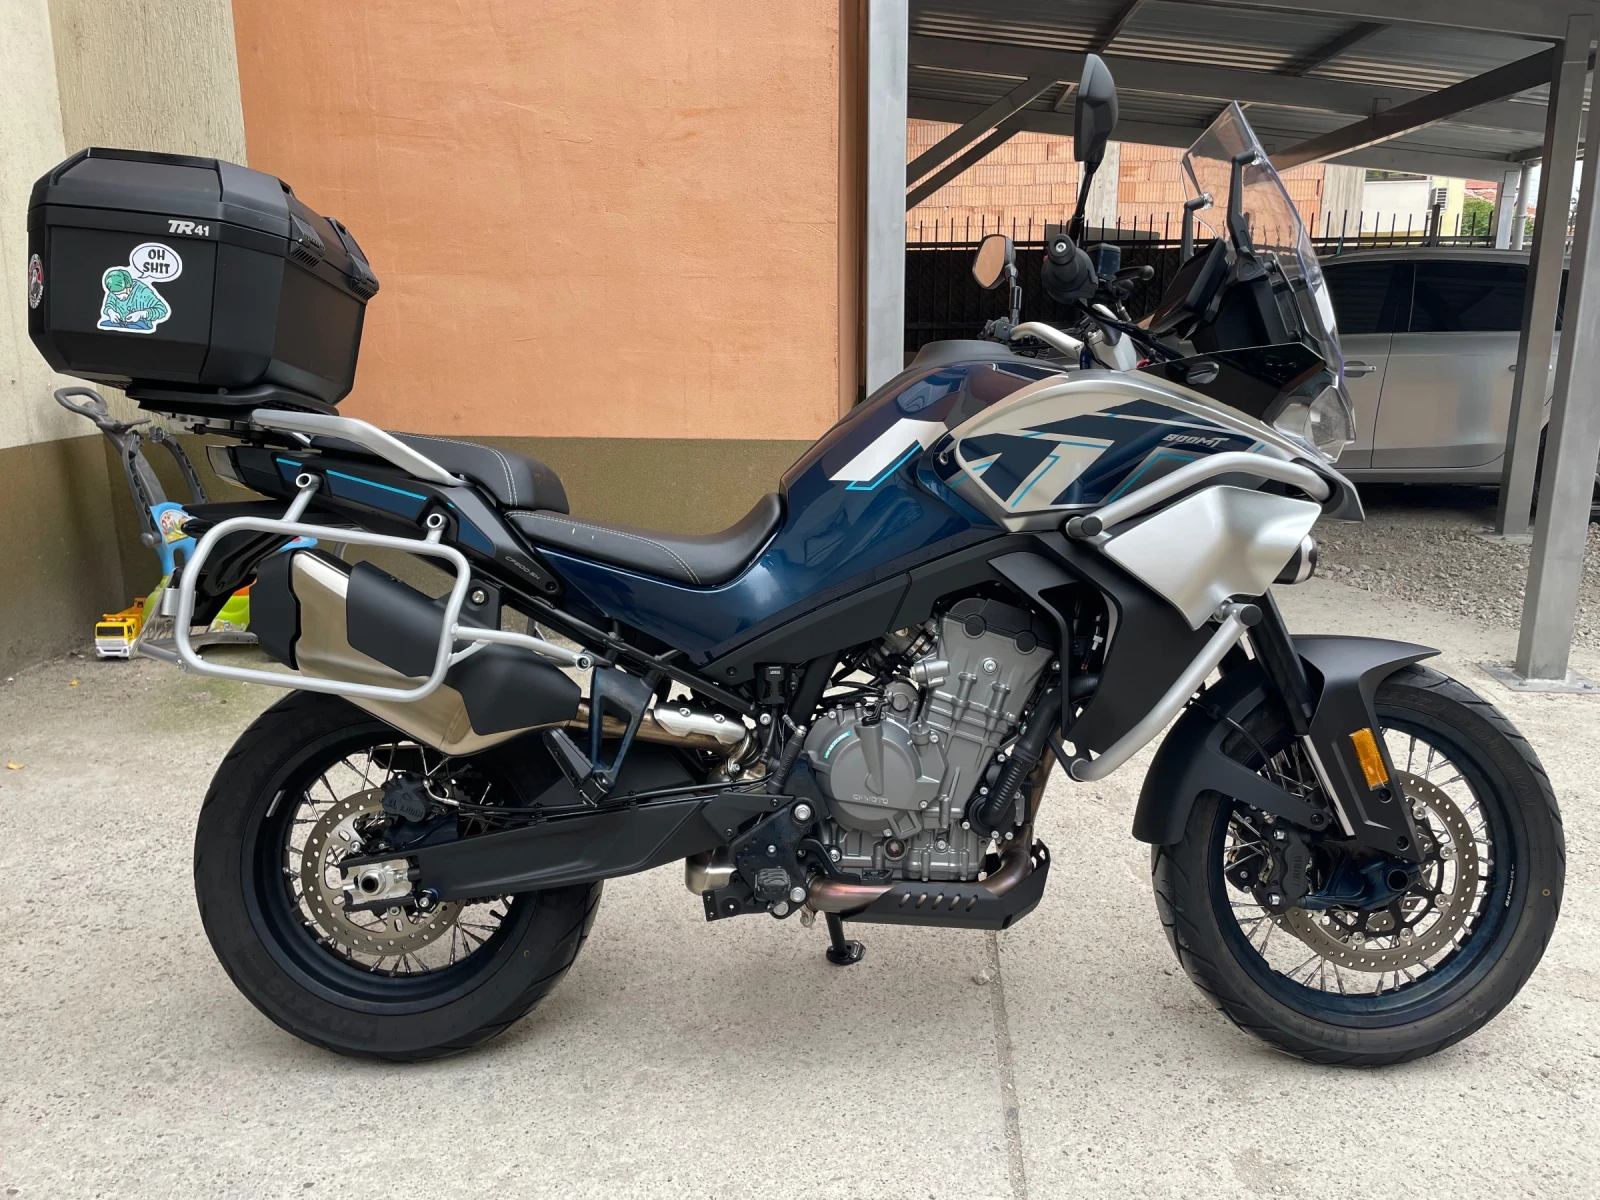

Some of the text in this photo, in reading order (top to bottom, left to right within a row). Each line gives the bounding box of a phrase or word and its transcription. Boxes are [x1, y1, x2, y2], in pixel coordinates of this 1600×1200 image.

[147, 248, 166, 260] OH
[142, 262, 171, 275] SHIT
[1162, 433, 1231, 448] 800MT
